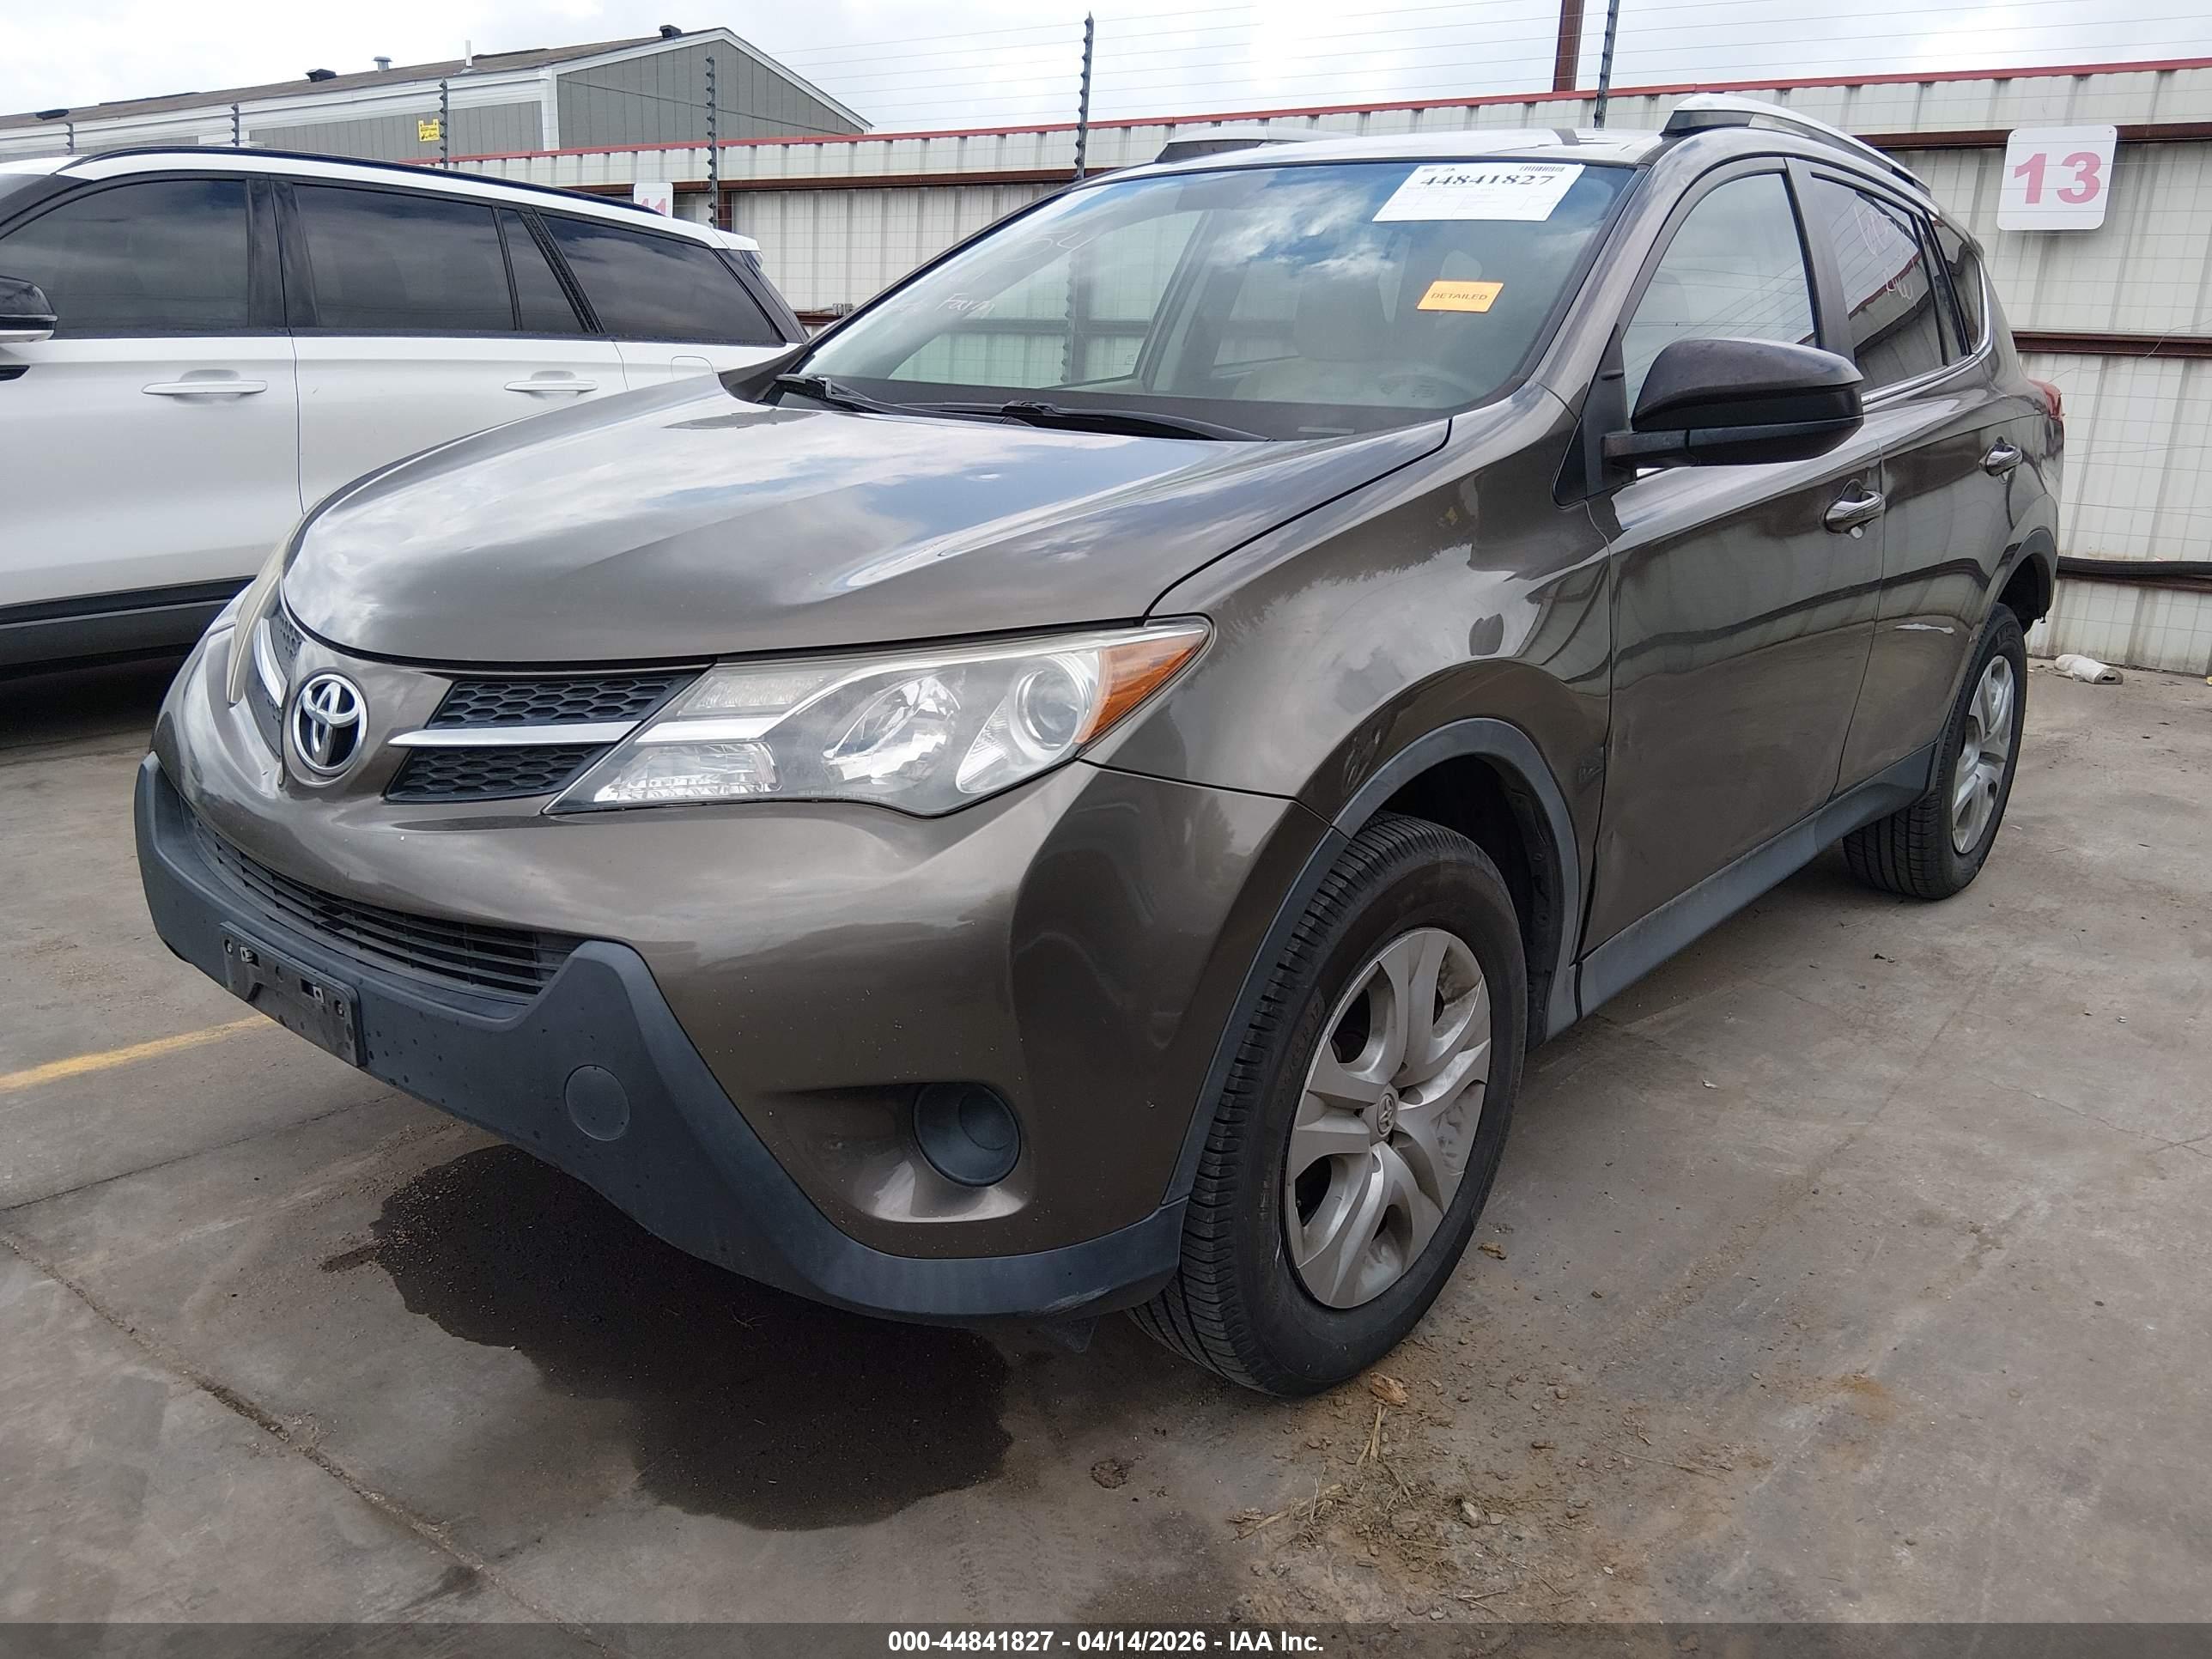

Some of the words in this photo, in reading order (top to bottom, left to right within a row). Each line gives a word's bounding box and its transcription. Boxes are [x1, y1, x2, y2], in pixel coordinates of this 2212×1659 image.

[1419, 173, 1555, 185] 44841827
[2014, 151, 2101, 204] 13
[1430, 292, 1489, 301] DETAILED
